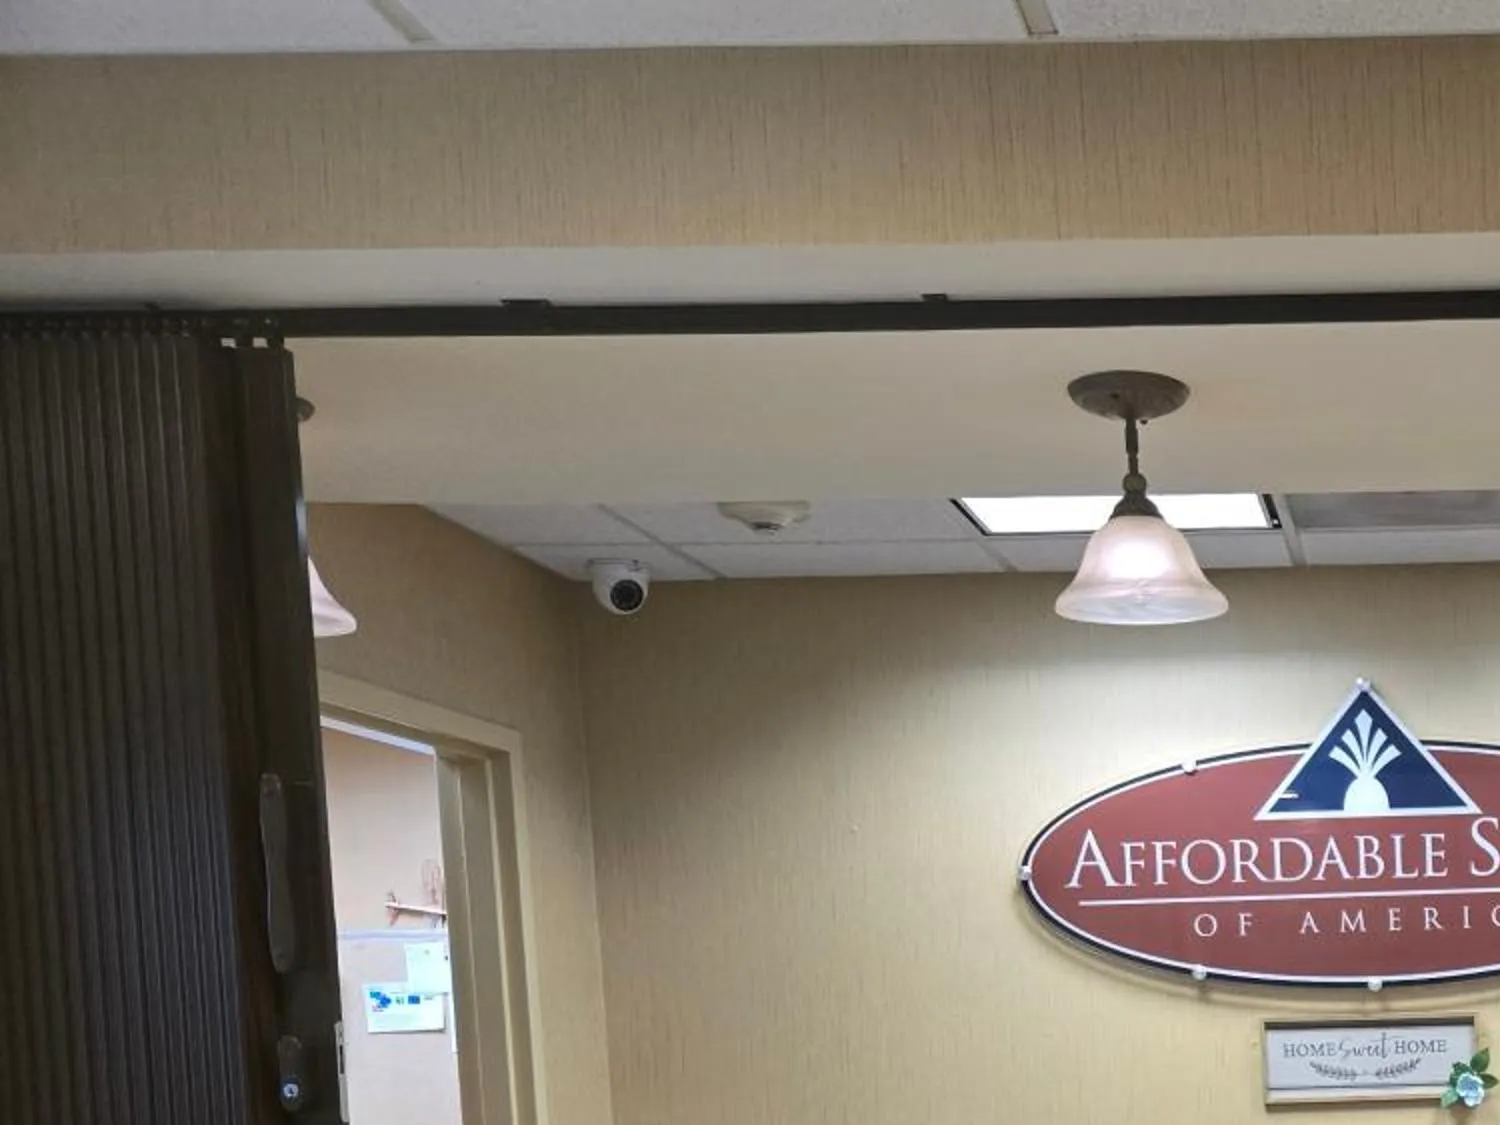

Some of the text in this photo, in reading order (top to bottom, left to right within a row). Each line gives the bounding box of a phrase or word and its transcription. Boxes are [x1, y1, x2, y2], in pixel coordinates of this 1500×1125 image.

[1064, 829, 1449, 889] AFFORDABLE
[1193, 913, 1254, 937] OF
[1283, 1042, 1337, 1059] HOME
[1393, 1039, 1448, 1055] HOME
